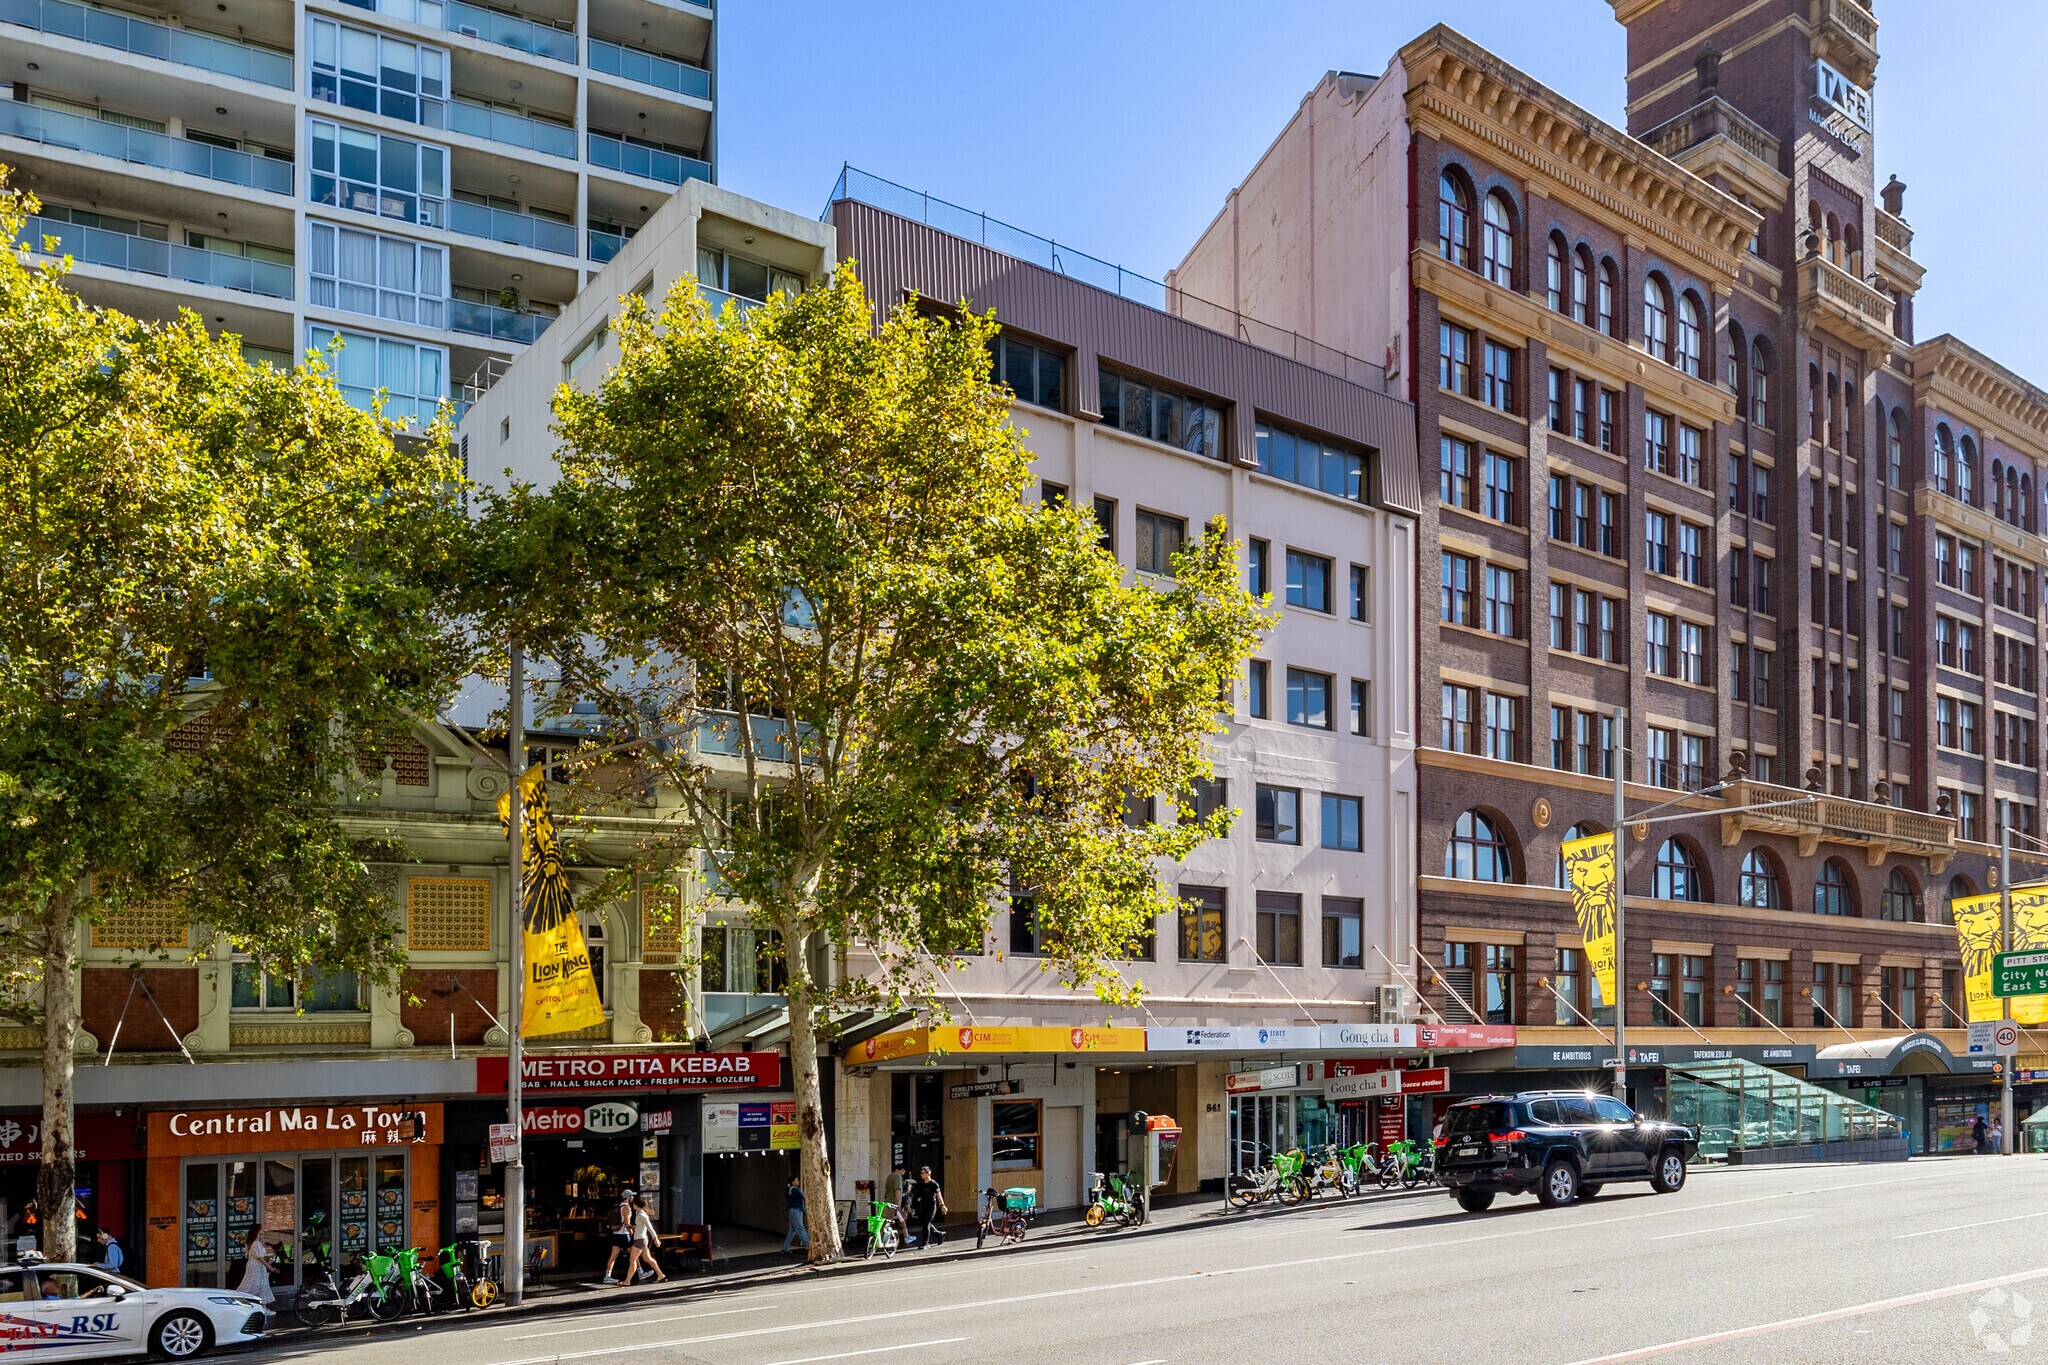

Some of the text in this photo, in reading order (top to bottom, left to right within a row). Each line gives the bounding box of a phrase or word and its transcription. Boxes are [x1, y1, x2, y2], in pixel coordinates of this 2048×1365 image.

[1822, 65, 1866, 125] TAFE
[1808, 107, 1863, 156] MARCUS CLARK
[554, 941, 568, 953] THE
[2006, 954, 2048, 965] PITT STR
[532, 954, 588, 983] LION KING
[2001, 970, 2028, 980] City
[2003, 981, 2031, 991] East
[974, 1033, 991, 1041] CIM
[1085, 1033, 1099, 1041] CIM
[1201, 1030, 1231, 1039] Federation
[1340, 1029, 1369, 1046] Gong
[1371, 1028, 1389, 1043] cha
[1421, 1026, 1437, 1046] tsg
[1999, 1032, 2013, 1041] 40
[876, 1041, 889, 1050] CIM
[1901, 1040, 1916, 1053] MARCUS
[1926, 1038, 1942, 1053] BUILDING
[1553, 1051, 1592, 1060] BE AMBITIOUS
[1693, 1050, 1733, 1058] TAFENSW.EDU.AU
[1763, 1050, 1792, 1058] BE AMBITIOUS
[521, 1056, 750, 1077] METRO PITA KEBAB
[583, 1079, 615, 1087] SNACK
[715, 1075, 756, 1083] GOZLEME
[1273, 1071, 1295, 1081] SCOTS
[1330, 1082, 1357, 1095] Gong
[1359, 1079, 1377, 1091] cha
[1400, 1080, 1421, 1088] bacco
[1206, 1103, 1221, 1112] 841
[169, 1110, 272, 1137] Central
[278, 1107, 318, 1131] Ma
[325, 1108, 356, 1130] La
[521, 1109, 581, 1131] Metro
[589, 1105, 630, 1128] Pita
[648, 1111, 672, 1129] KEBAB
[27, 1150, 86, 1160] SKRS
[7, 1312, 120, 1341] TAXI RSL
